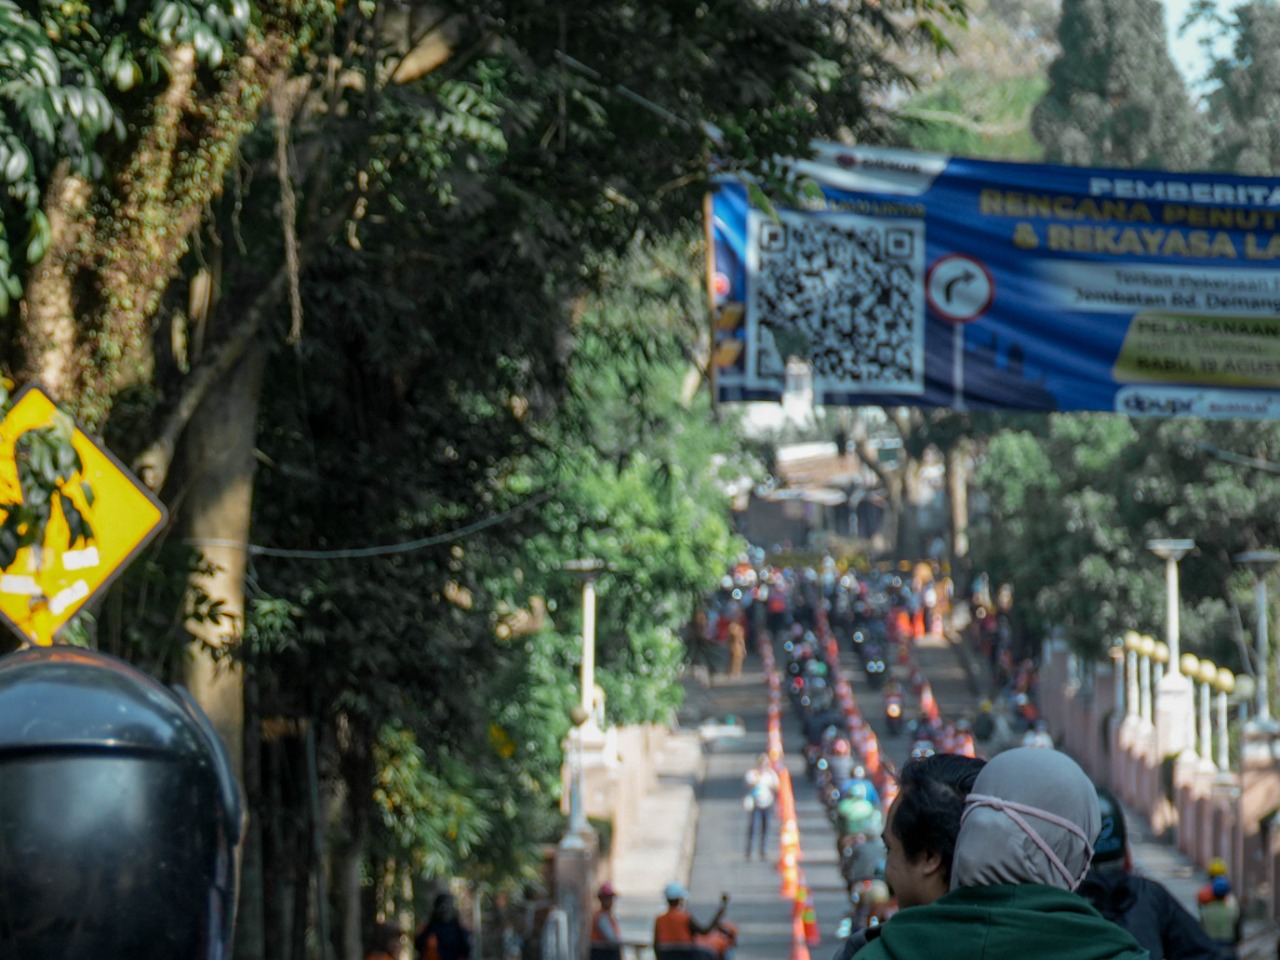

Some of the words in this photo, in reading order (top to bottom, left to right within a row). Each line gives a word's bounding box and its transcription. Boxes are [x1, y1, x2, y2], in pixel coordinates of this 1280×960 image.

[980, 189, 1153, 223] RENCANA
[1014, 222, 1039, 250] &
[1047, 223, 1237, 259] REKAYASA
